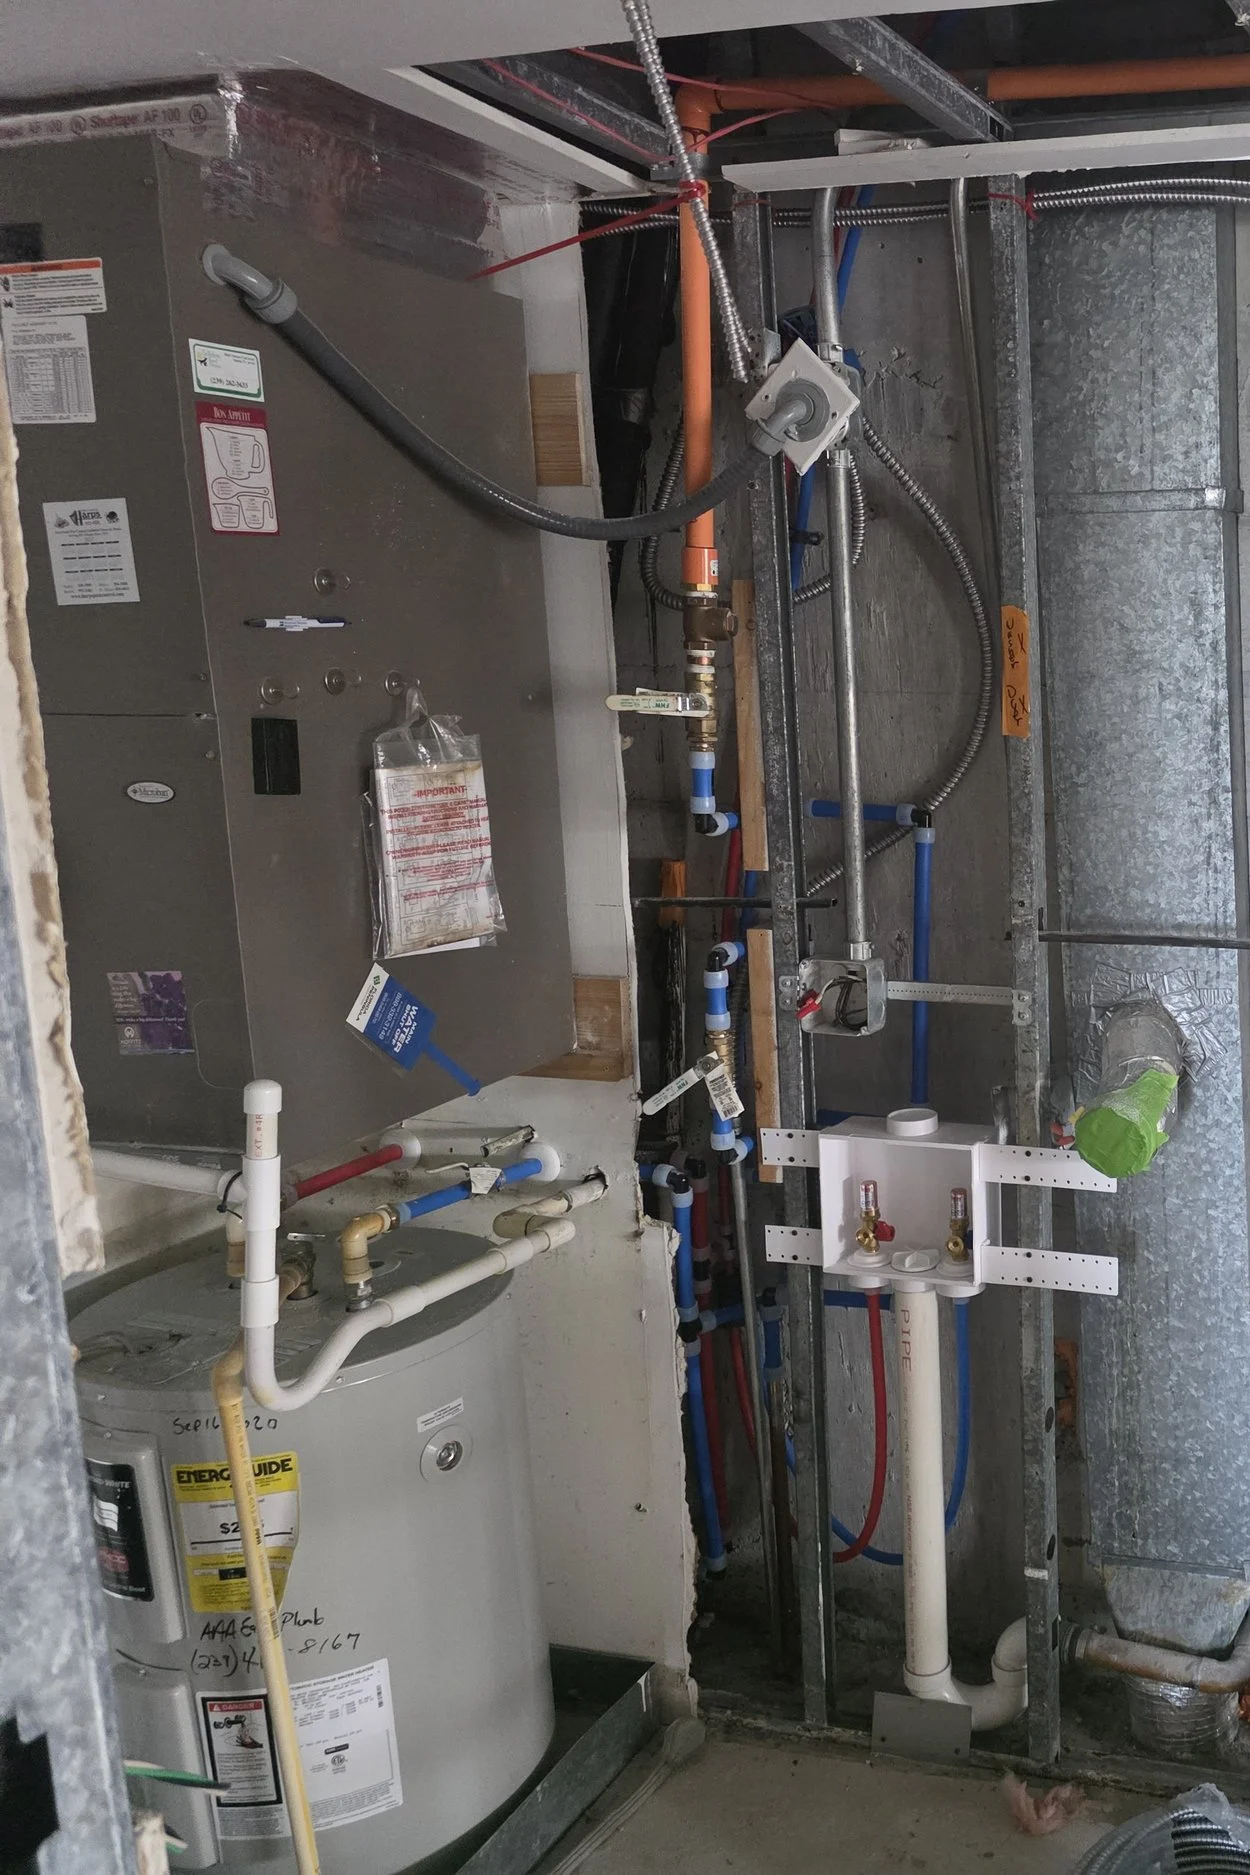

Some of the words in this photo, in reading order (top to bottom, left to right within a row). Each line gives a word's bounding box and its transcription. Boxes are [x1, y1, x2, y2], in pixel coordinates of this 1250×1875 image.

[399, 1004, 411, 1027] SHUT
[392, 1028, 401, 1046] OFF
[394, 1005, 418, 1053] WATER
[405, 1021, 417, 1044] MAIN
[901, 1308, 911, 1372] PIPE
